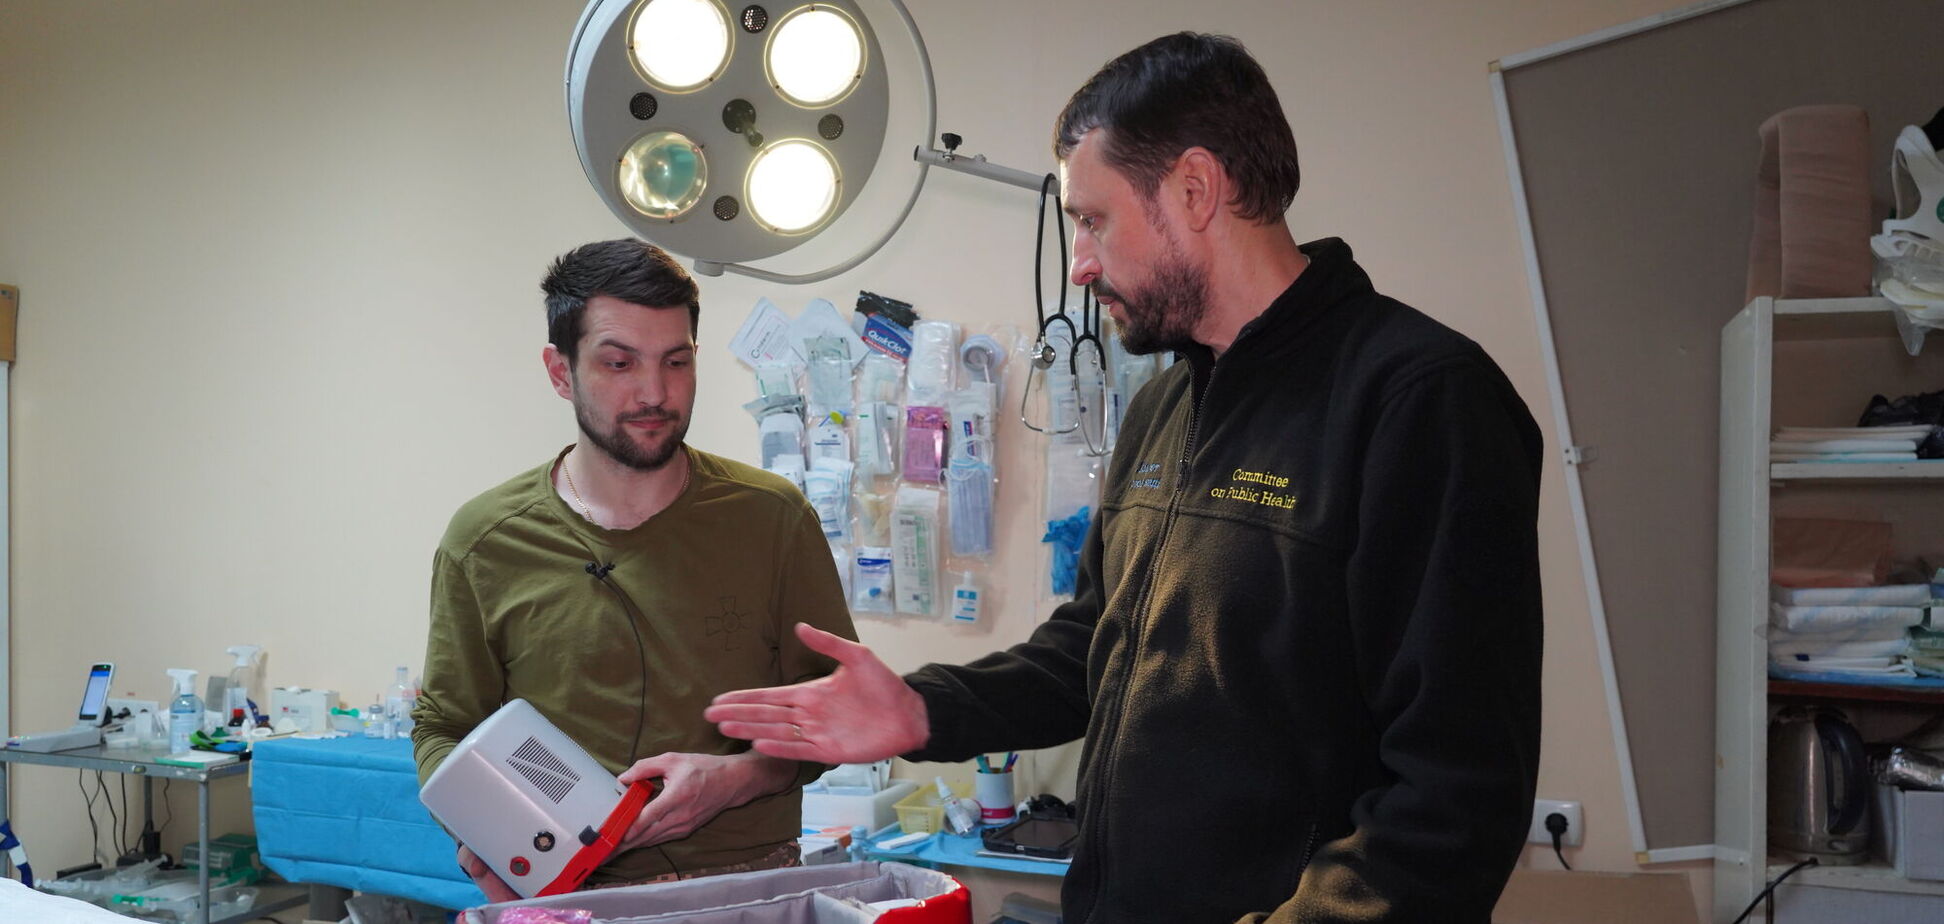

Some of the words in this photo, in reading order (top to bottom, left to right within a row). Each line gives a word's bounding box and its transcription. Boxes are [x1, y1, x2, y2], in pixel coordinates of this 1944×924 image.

[868, 330, 907, 354] QuikClot
[1232, 468, 1289, 488] Committee
[1210, 487, 1226, 499] on
